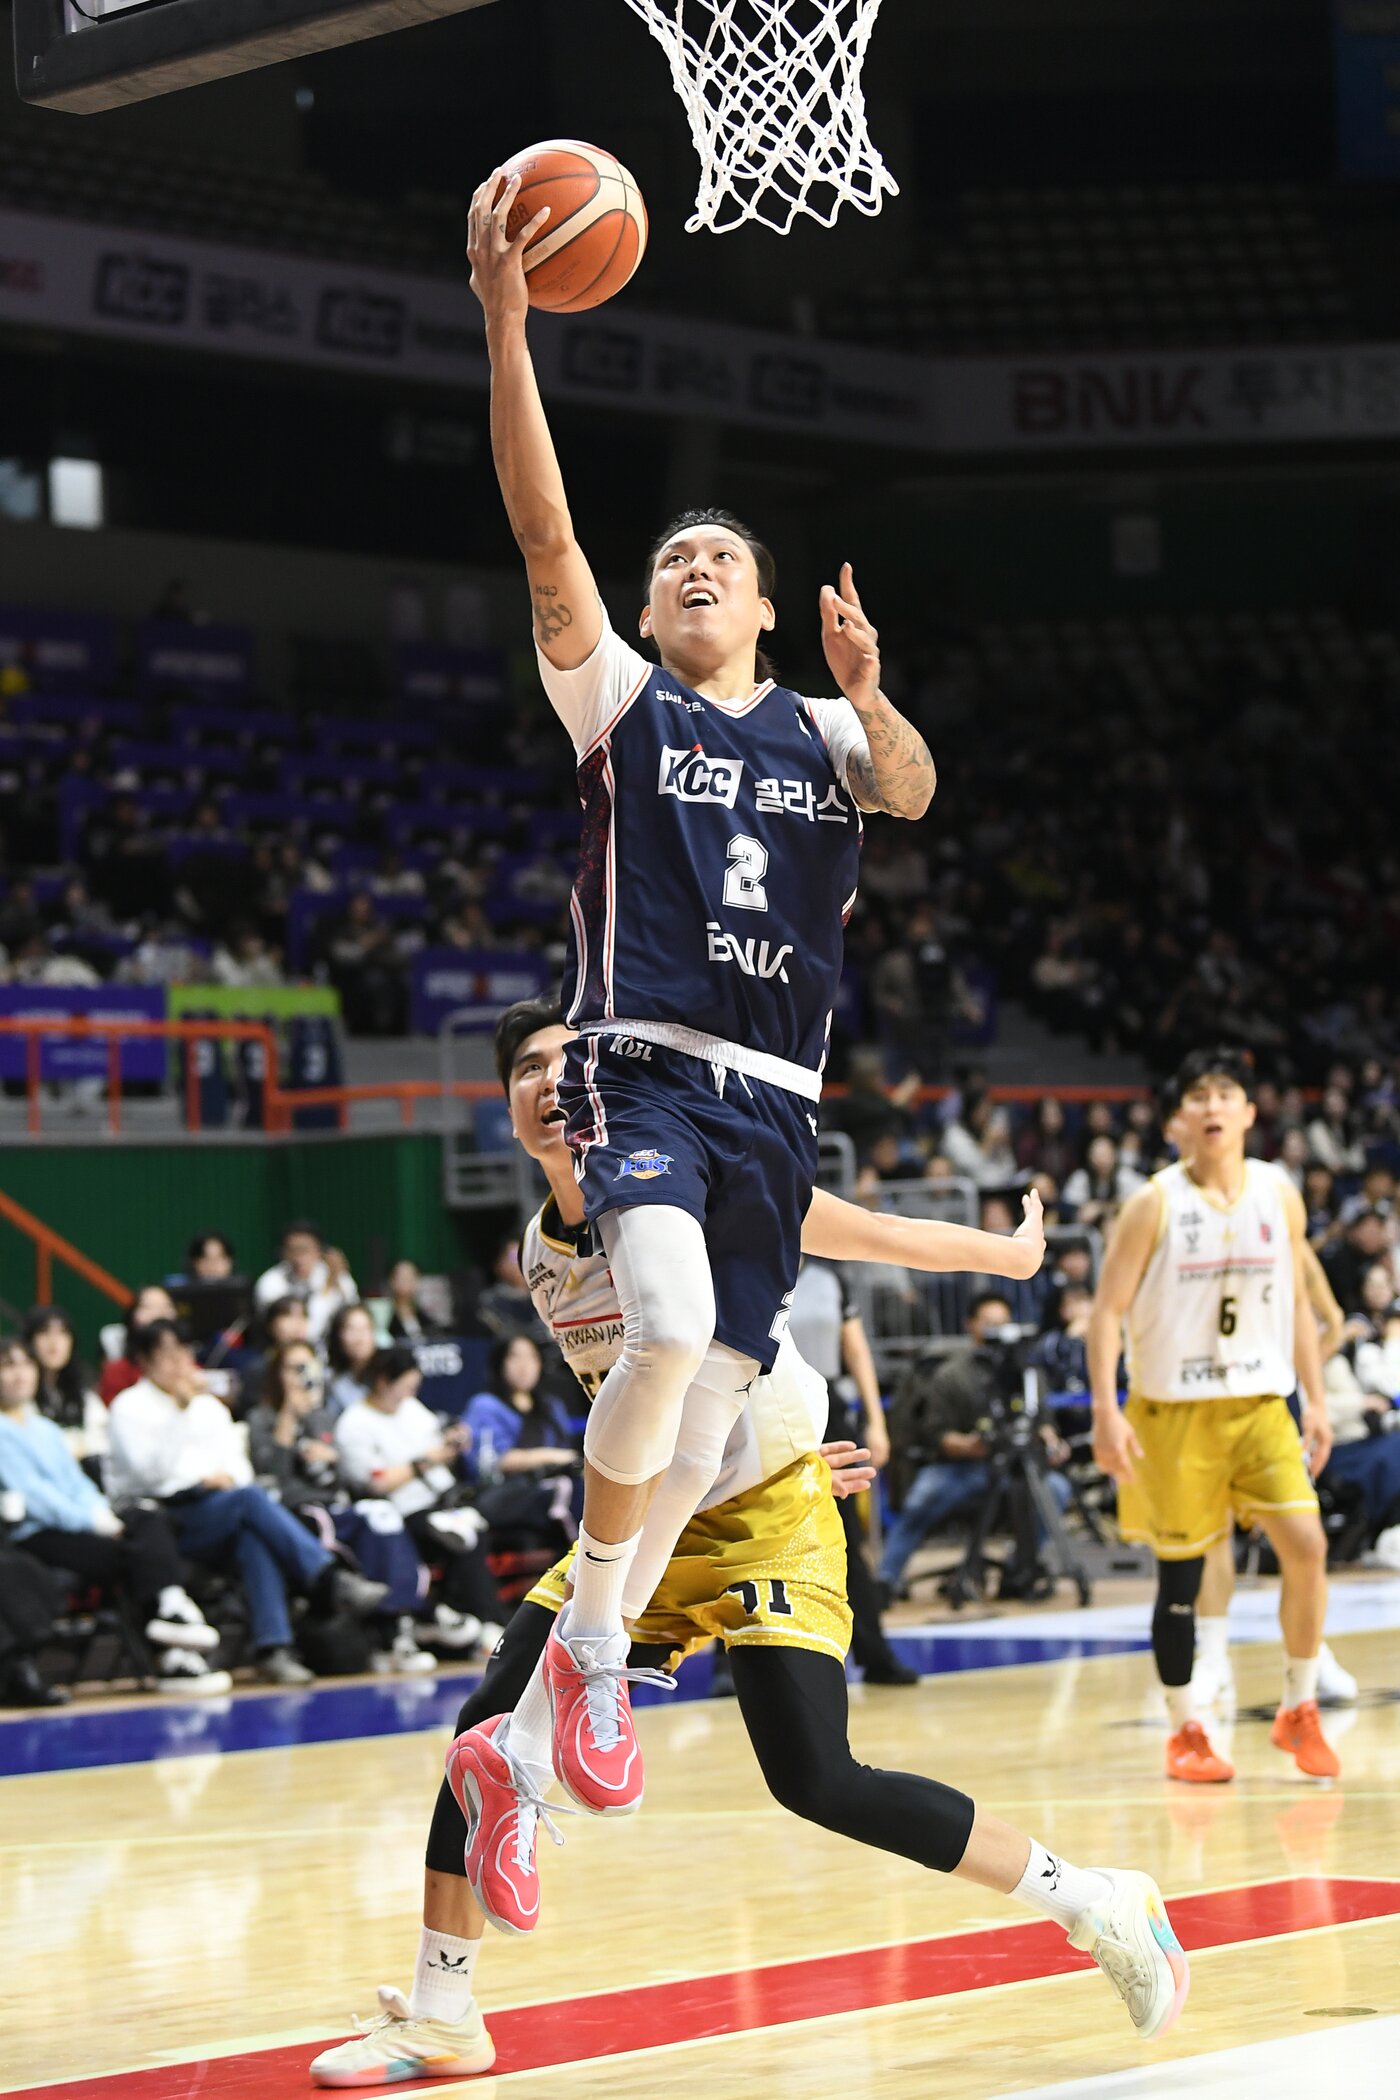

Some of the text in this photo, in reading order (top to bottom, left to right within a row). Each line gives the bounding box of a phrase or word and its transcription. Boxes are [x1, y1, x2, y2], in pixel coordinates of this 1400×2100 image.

[1013, 367, 1208, 434] BNK
[664, 744, 734, 799] KCC
[722, 833, 769, 912] 2
[1219, 1296, 1237, 1337] 6
